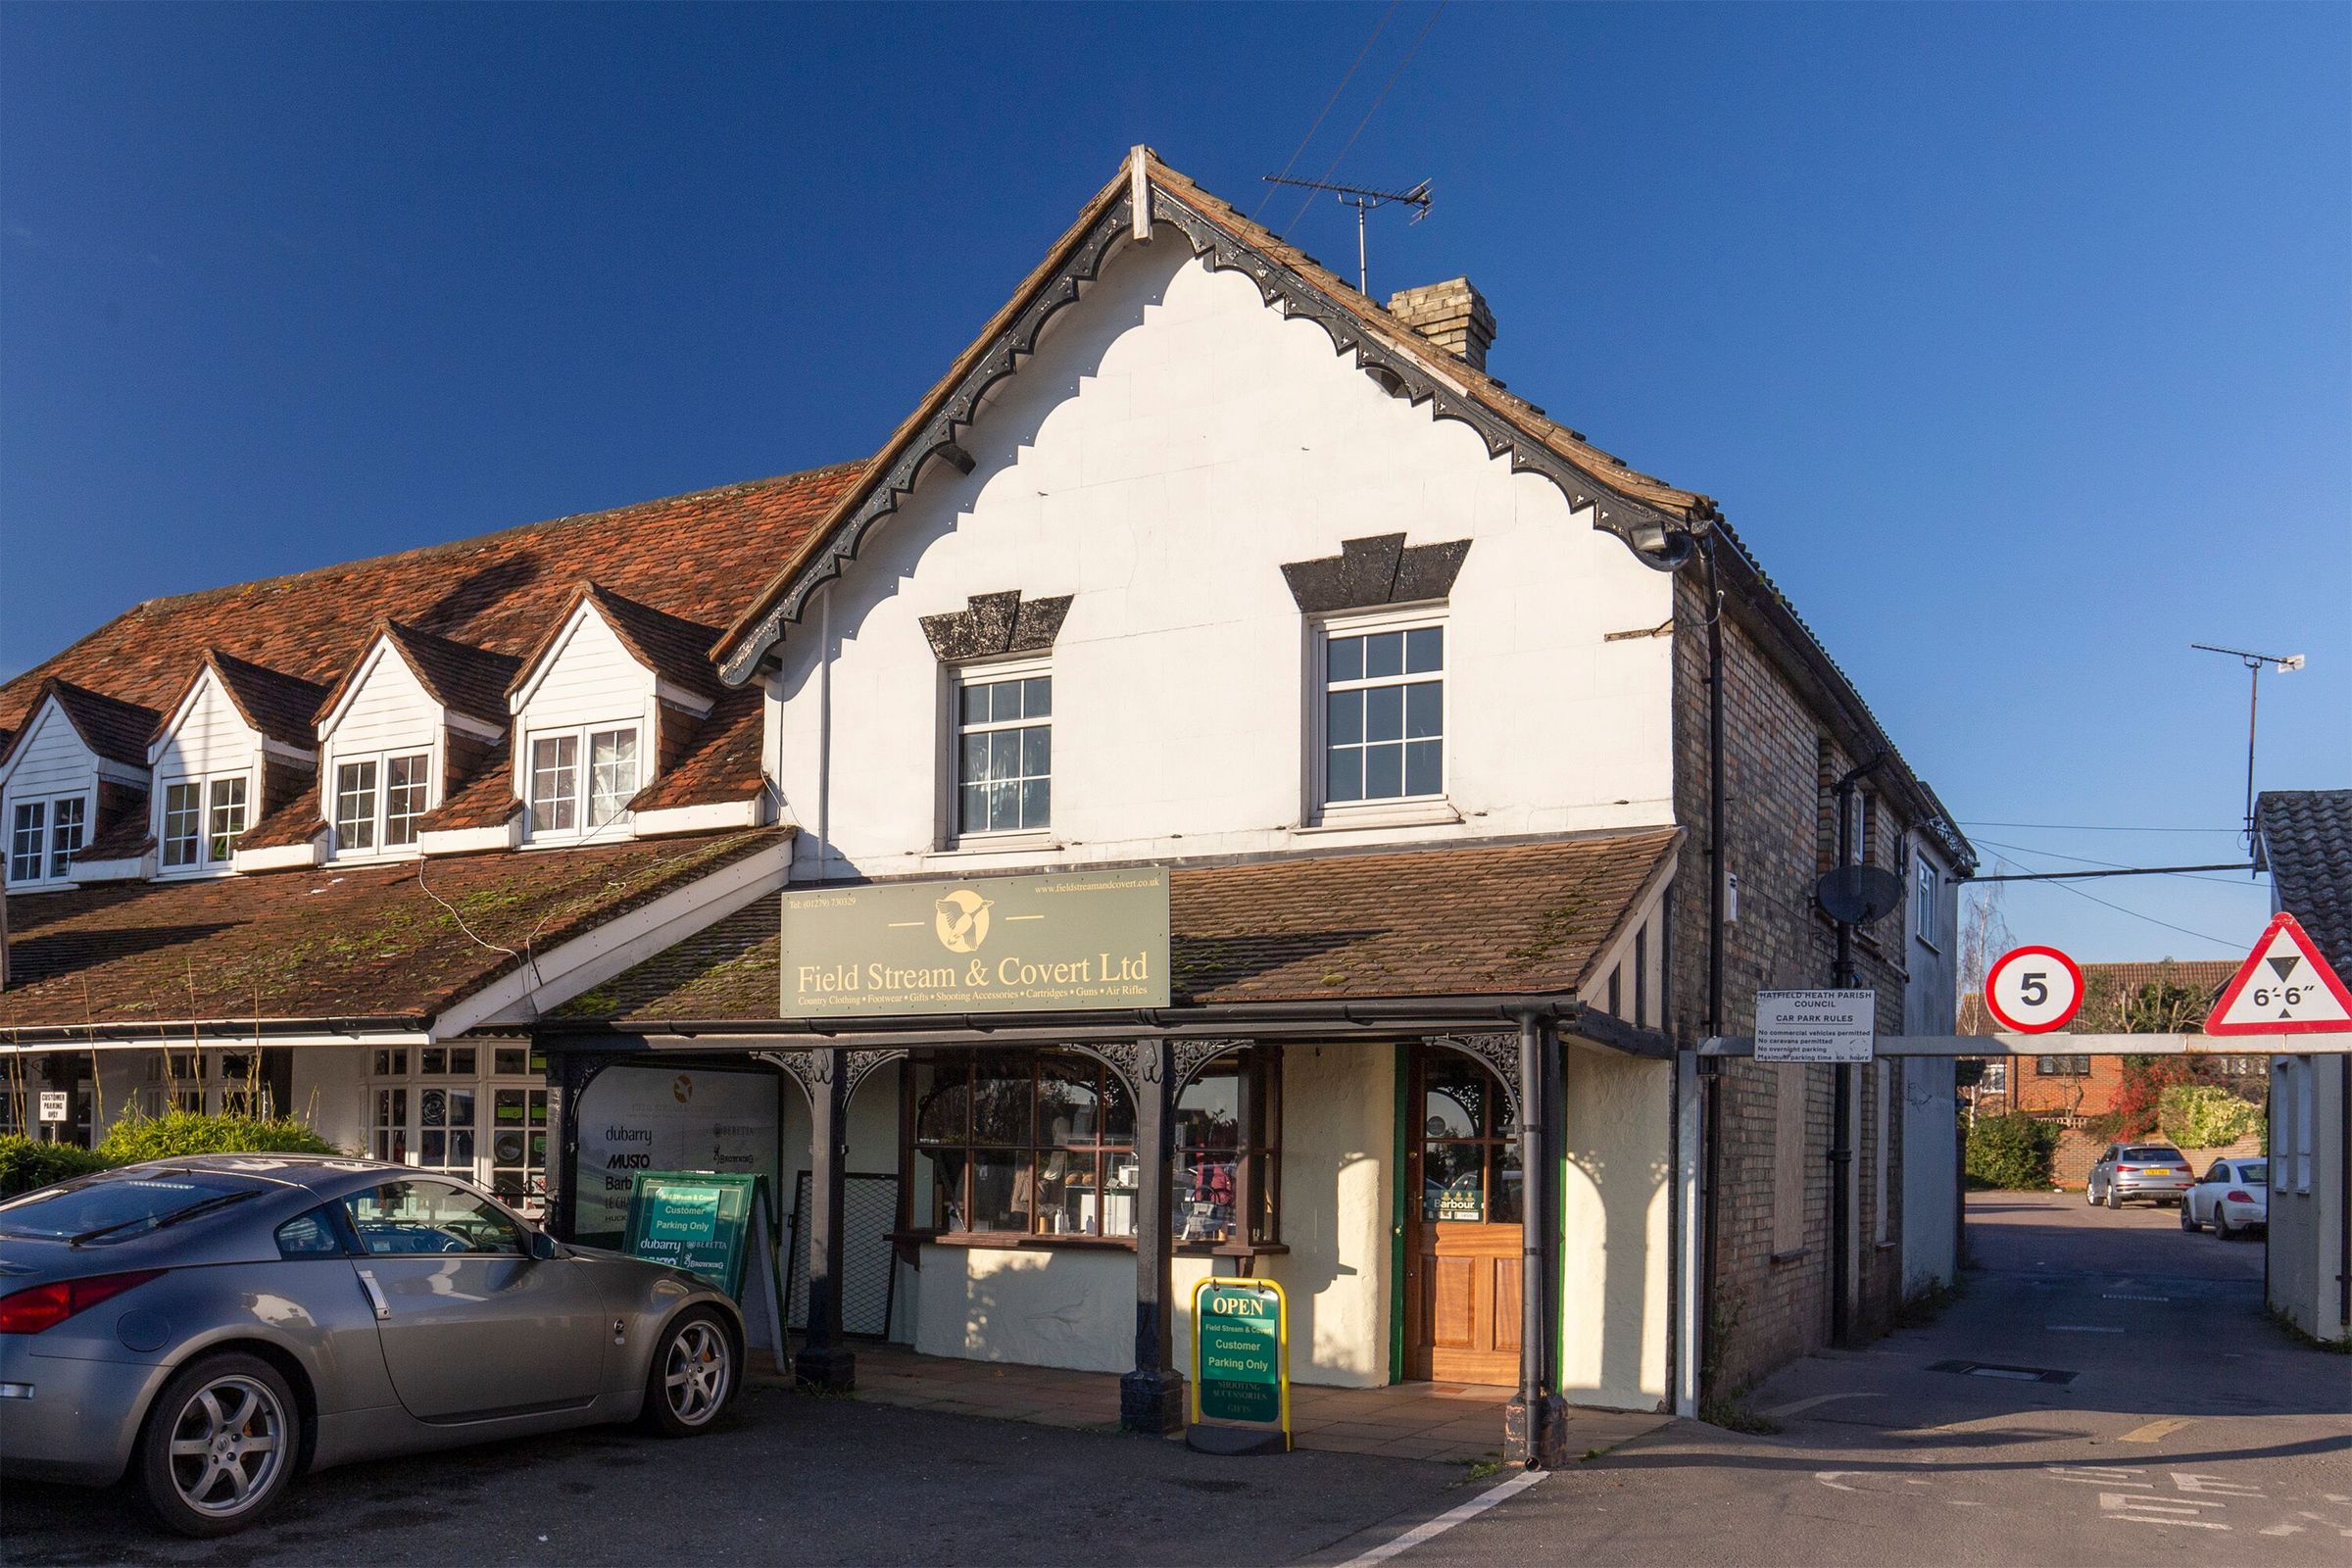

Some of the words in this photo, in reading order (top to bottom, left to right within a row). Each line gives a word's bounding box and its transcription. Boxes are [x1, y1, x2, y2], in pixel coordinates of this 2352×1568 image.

[1034, 878, 1160, 894] www.fieldstreamandcovert.co.uk
[803, 899, 830, 910] (01279)
[831, 898, 857, 907] 730329
[798, 963, 859, 994] Field
[867, 962, 956, 991] Stream
[965, 958, 990, 988] &
[998, 956, 1091, 986] Covert
[1099, 951, 1149, 982] Ltd
[798, 996, 827, 1006] Country
[829, 994, 860, 1004] Clothing
[867, 994, 902, 1003] Footwear
[909, 992, 929, 1003] Gifts
[936, 991, 971, 1003] Shooting
[972, 990, 1018, 1001] Accessories
[1026, 988, 1068, 1000] Cartridges
[1076, 987, 1098, 997] Guns
[1105, 986, 1119, 996] Air
[1122, 985, 1148, 995] Rifles
[2021, 972, 2048, 1006] 5
[606, 1126, 652, 1146] dubarry
[606, 1153, 651, 1169] MUSTO
[665, 1205, 706, 1215] Customer
[1434, 1199, 1476, 1209] Barbour
[656, 1220, 688, 1231] Parking
[689, 1221, 710, 1233] Only
[640, 1238, 682, 1253] dubarry
[1212, 1297, 1265, 1316] OPEN
[1221, 1324, 1244, 1333] Stream
[1215, 1339, 1261, 1351] Customer
[1208, 1356, 1245, 1371] Parking
[1246, 1358, 1269, 1372] Only
